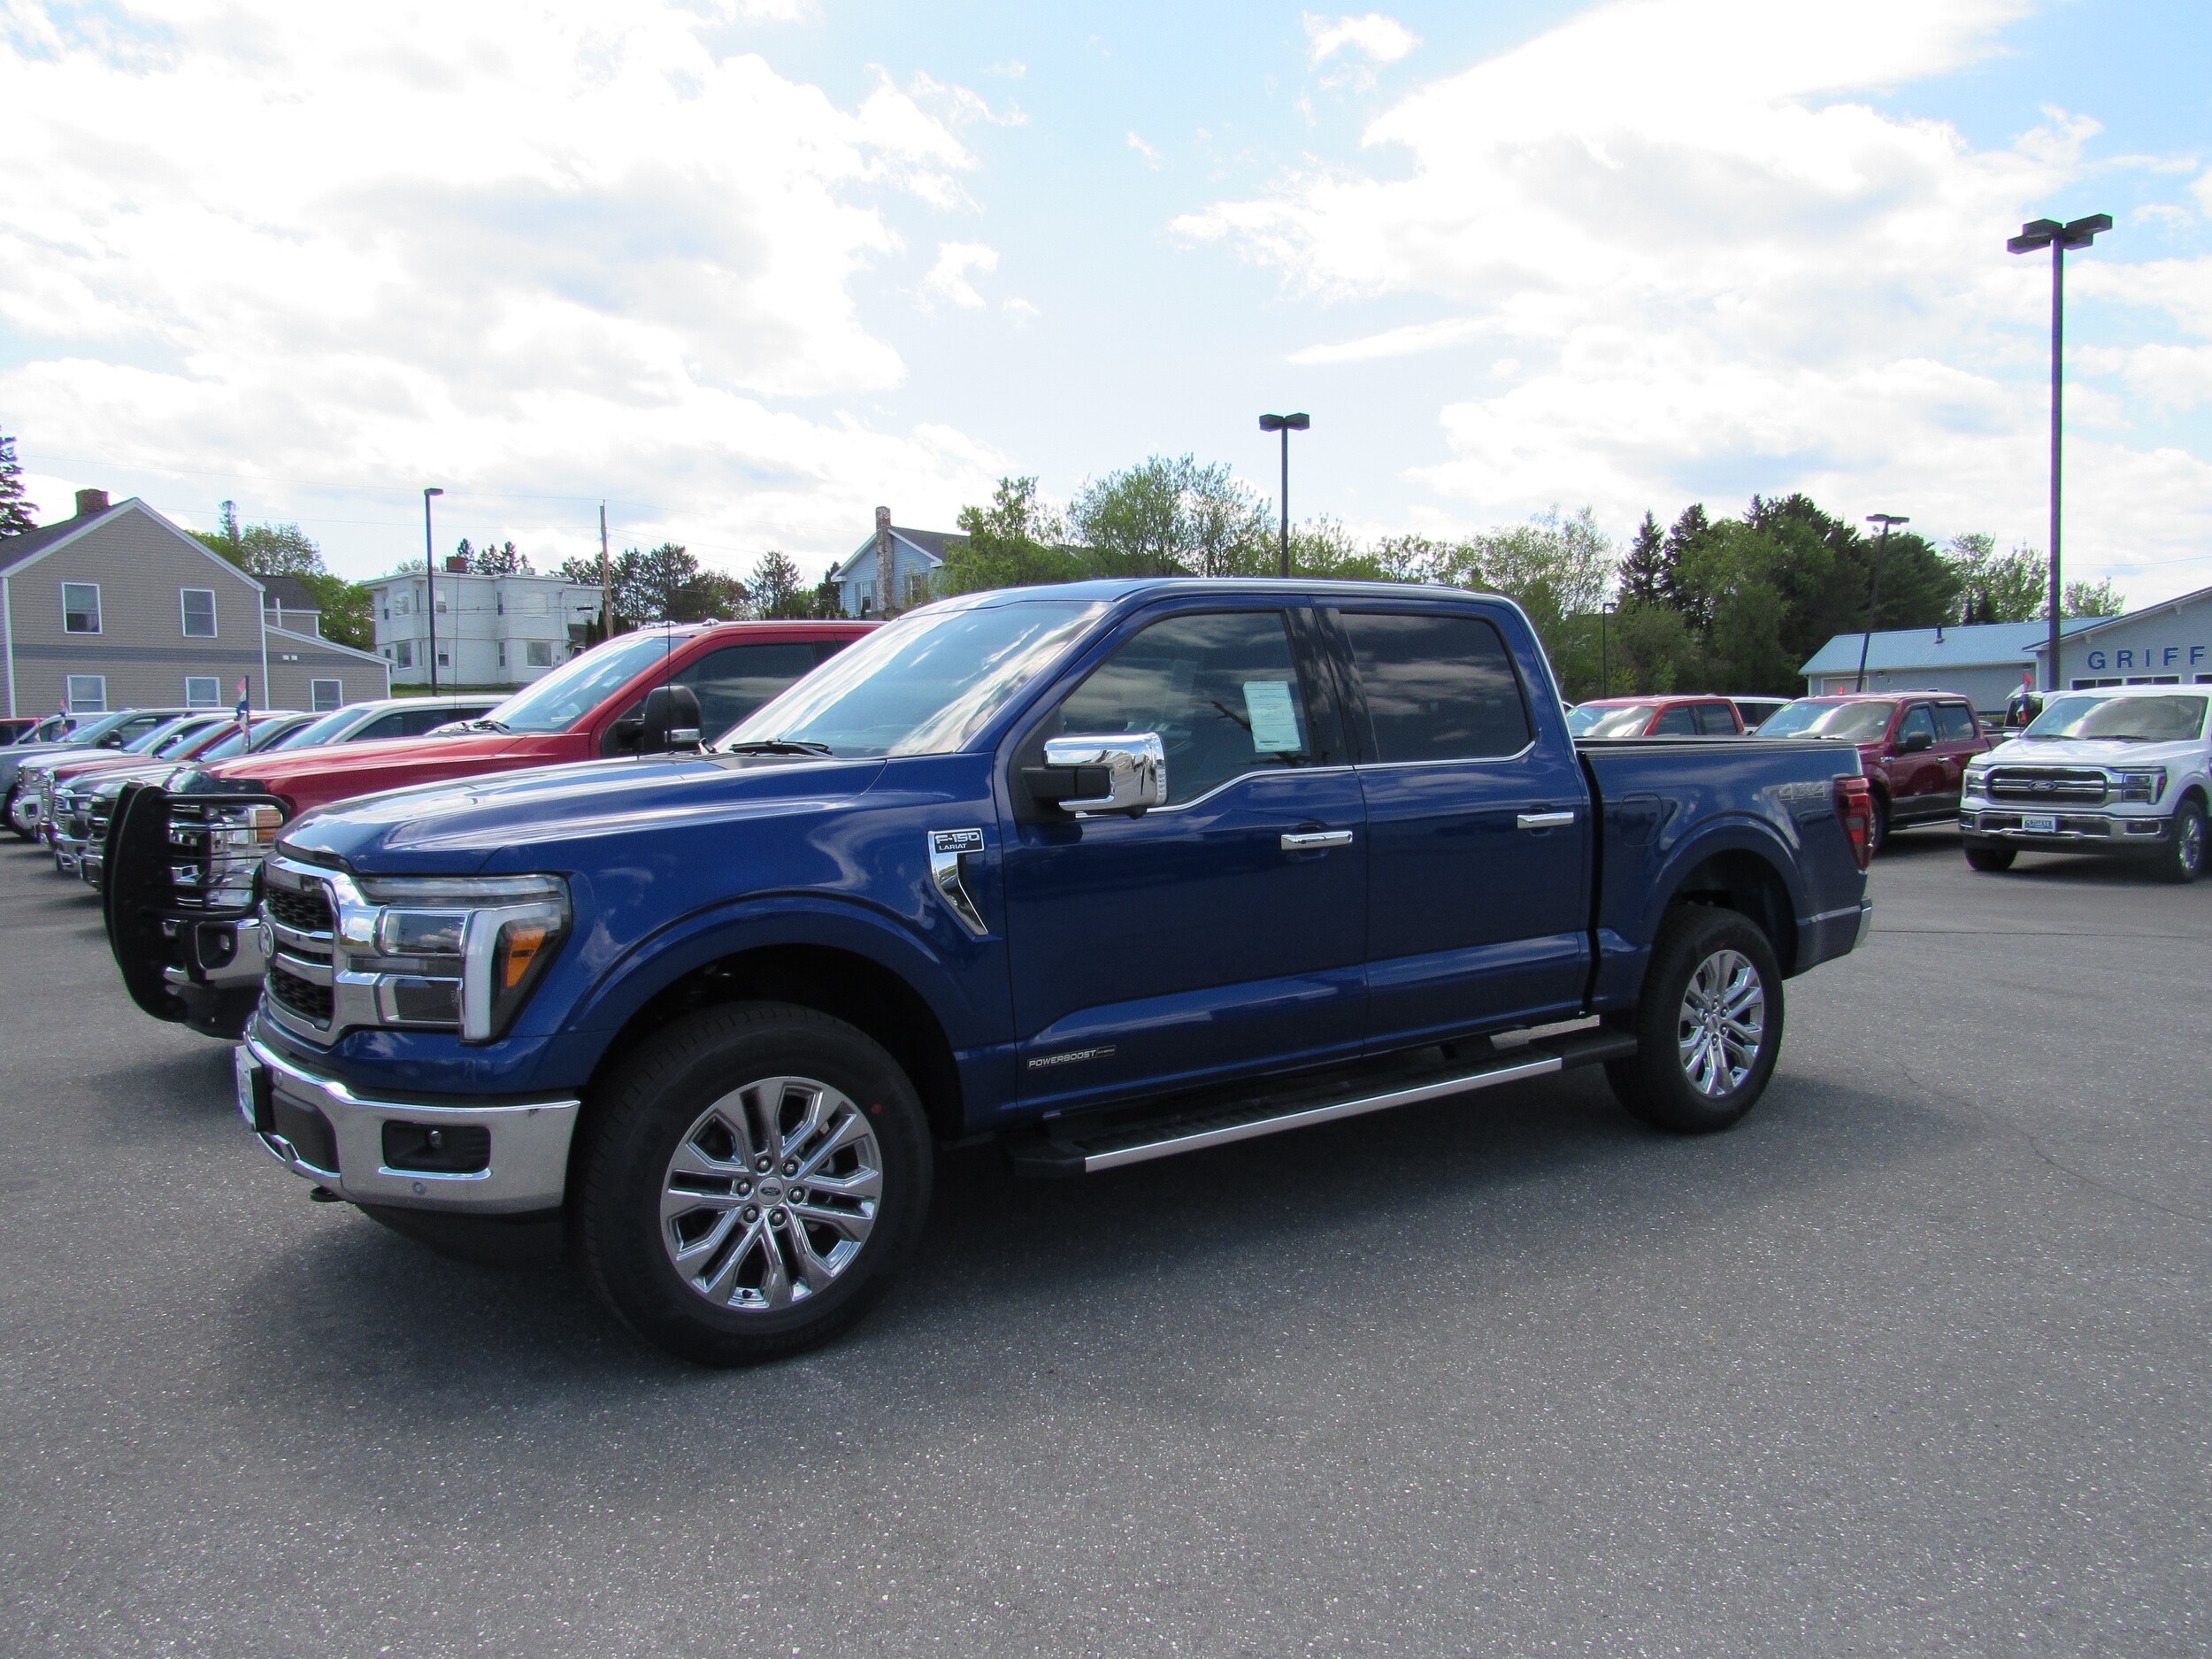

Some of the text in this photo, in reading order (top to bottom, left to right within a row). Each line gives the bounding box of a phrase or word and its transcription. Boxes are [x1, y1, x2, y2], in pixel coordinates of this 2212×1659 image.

[2087, 646, 2206, 670] GRIFF
[935, 832, 980, 844] F-150
[1029, 1049, 1097, 1068] POWERBOOST
